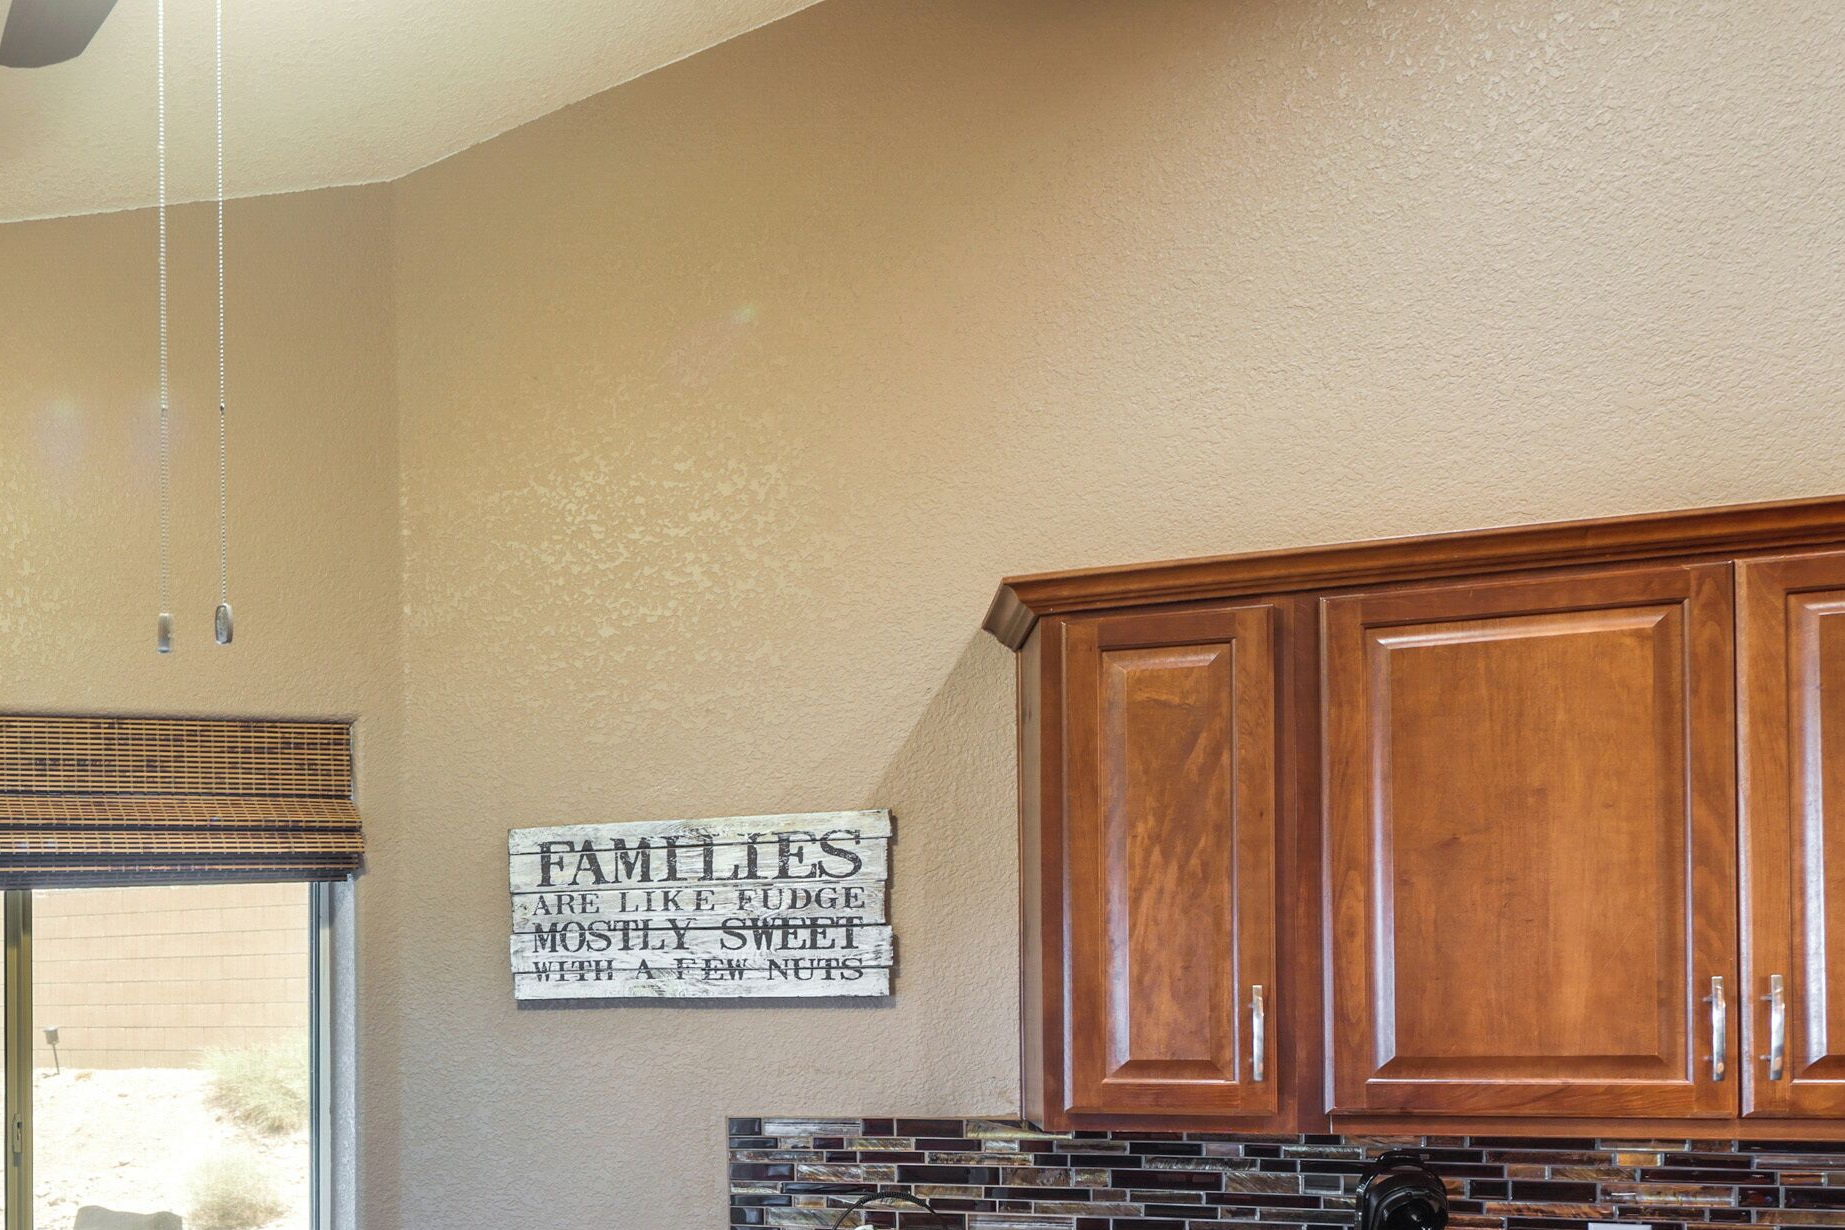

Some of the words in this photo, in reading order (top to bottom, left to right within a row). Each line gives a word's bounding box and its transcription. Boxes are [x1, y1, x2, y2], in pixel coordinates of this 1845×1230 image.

[536, 829, 863, 888] FAMILIES
[532, 893, 600, 916] ARE
[618, 889, 715, 913] LIKE
[735, 886, 865, 911] FUDGE
[531, 918, 697, 953] MOSTLY
[720, 916, 864, 951] SWEET
[532, 959, 615, 982] WITH
[635, 958, 656, 980] A
[673, 958, 749, 981] FEW
[766, 957, 864, 981] NUTS
